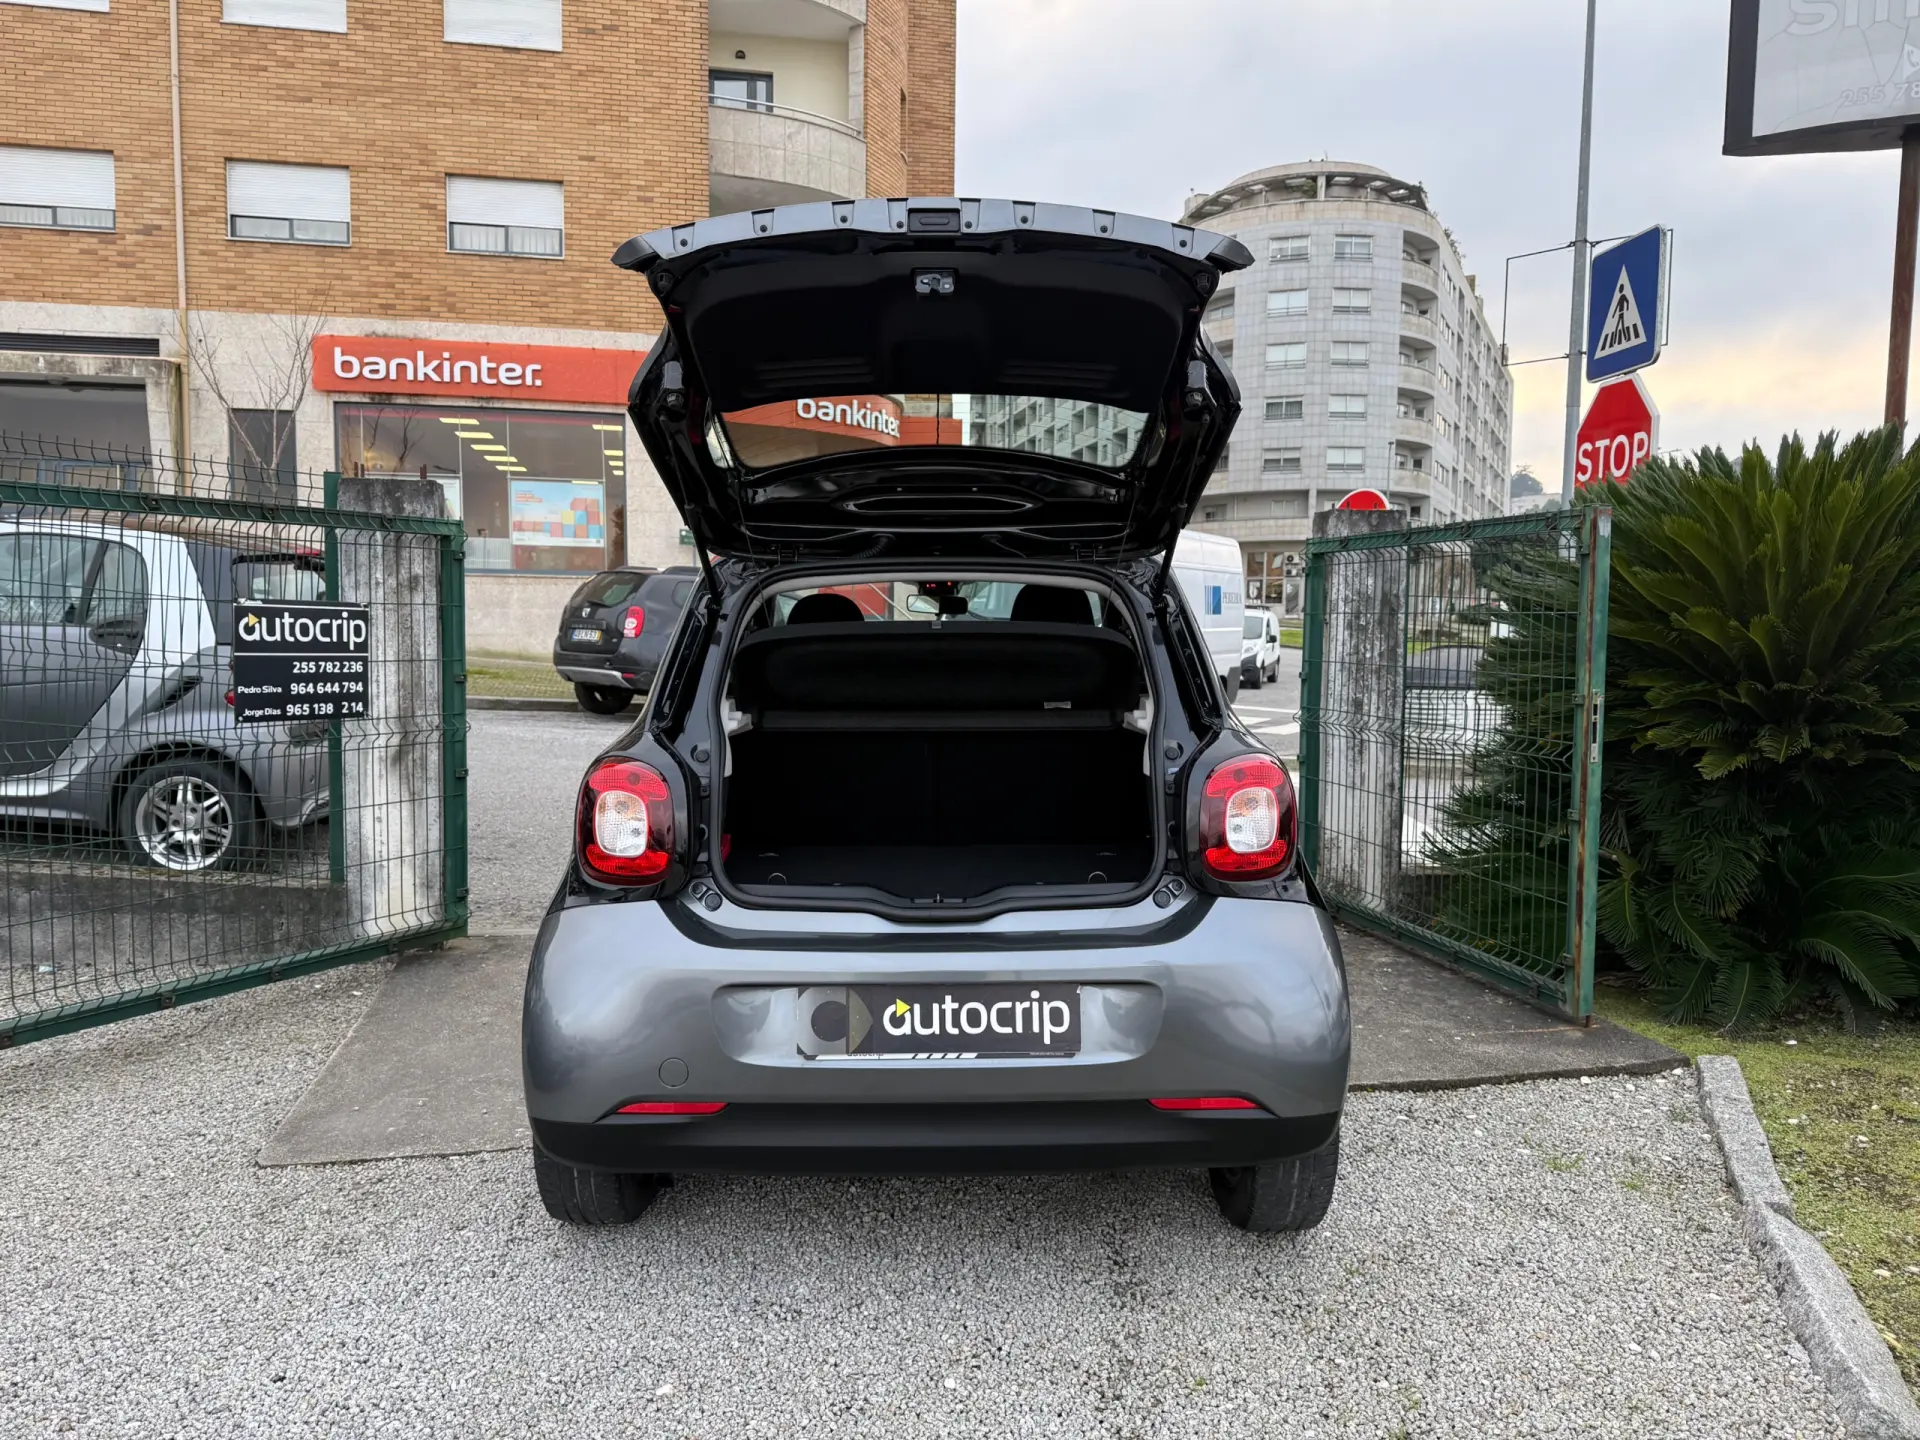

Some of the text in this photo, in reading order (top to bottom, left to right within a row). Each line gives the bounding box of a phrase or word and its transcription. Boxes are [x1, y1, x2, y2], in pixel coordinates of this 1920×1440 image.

[1840, 84, 1886, 107] 255
[1577, 431, 1649, 482] STOP
[238, 611, 367, 650] autocrip
[293, 661, 364, 673] 255 782 236
[237, 681, 364, 694] Pedro Silva 964 644 794
[242, 708, 264, 718] Jorge
[264, 707, 282, 716] Dias
[286, 703, 310, 716] 965
[312, 702, 334, 714] 138
[882, 990, 1070, 1045] autocrip
